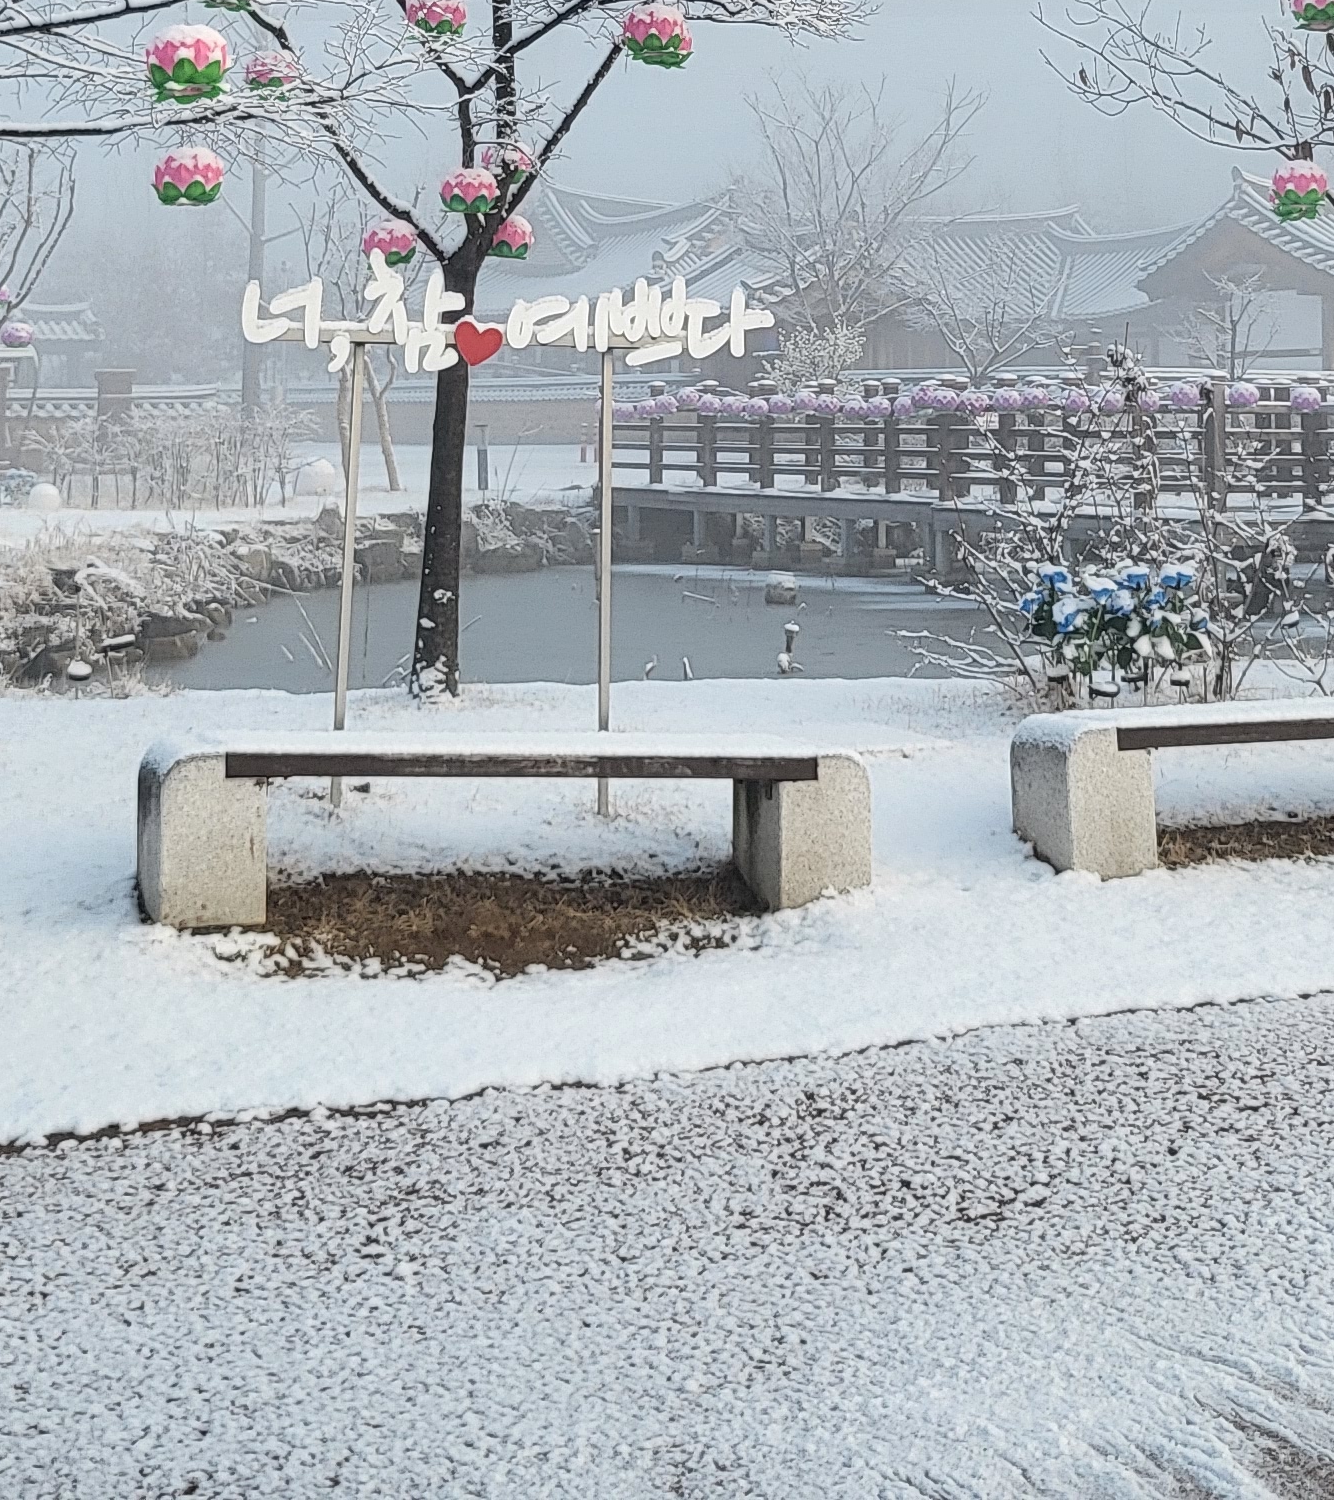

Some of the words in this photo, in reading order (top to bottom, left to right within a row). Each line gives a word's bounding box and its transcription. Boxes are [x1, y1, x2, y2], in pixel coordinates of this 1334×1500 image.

[242, 276, 351, 373] 너,
[364, 248, 466, 374] 참
[506, 275, 776, 367] 예쁘다
